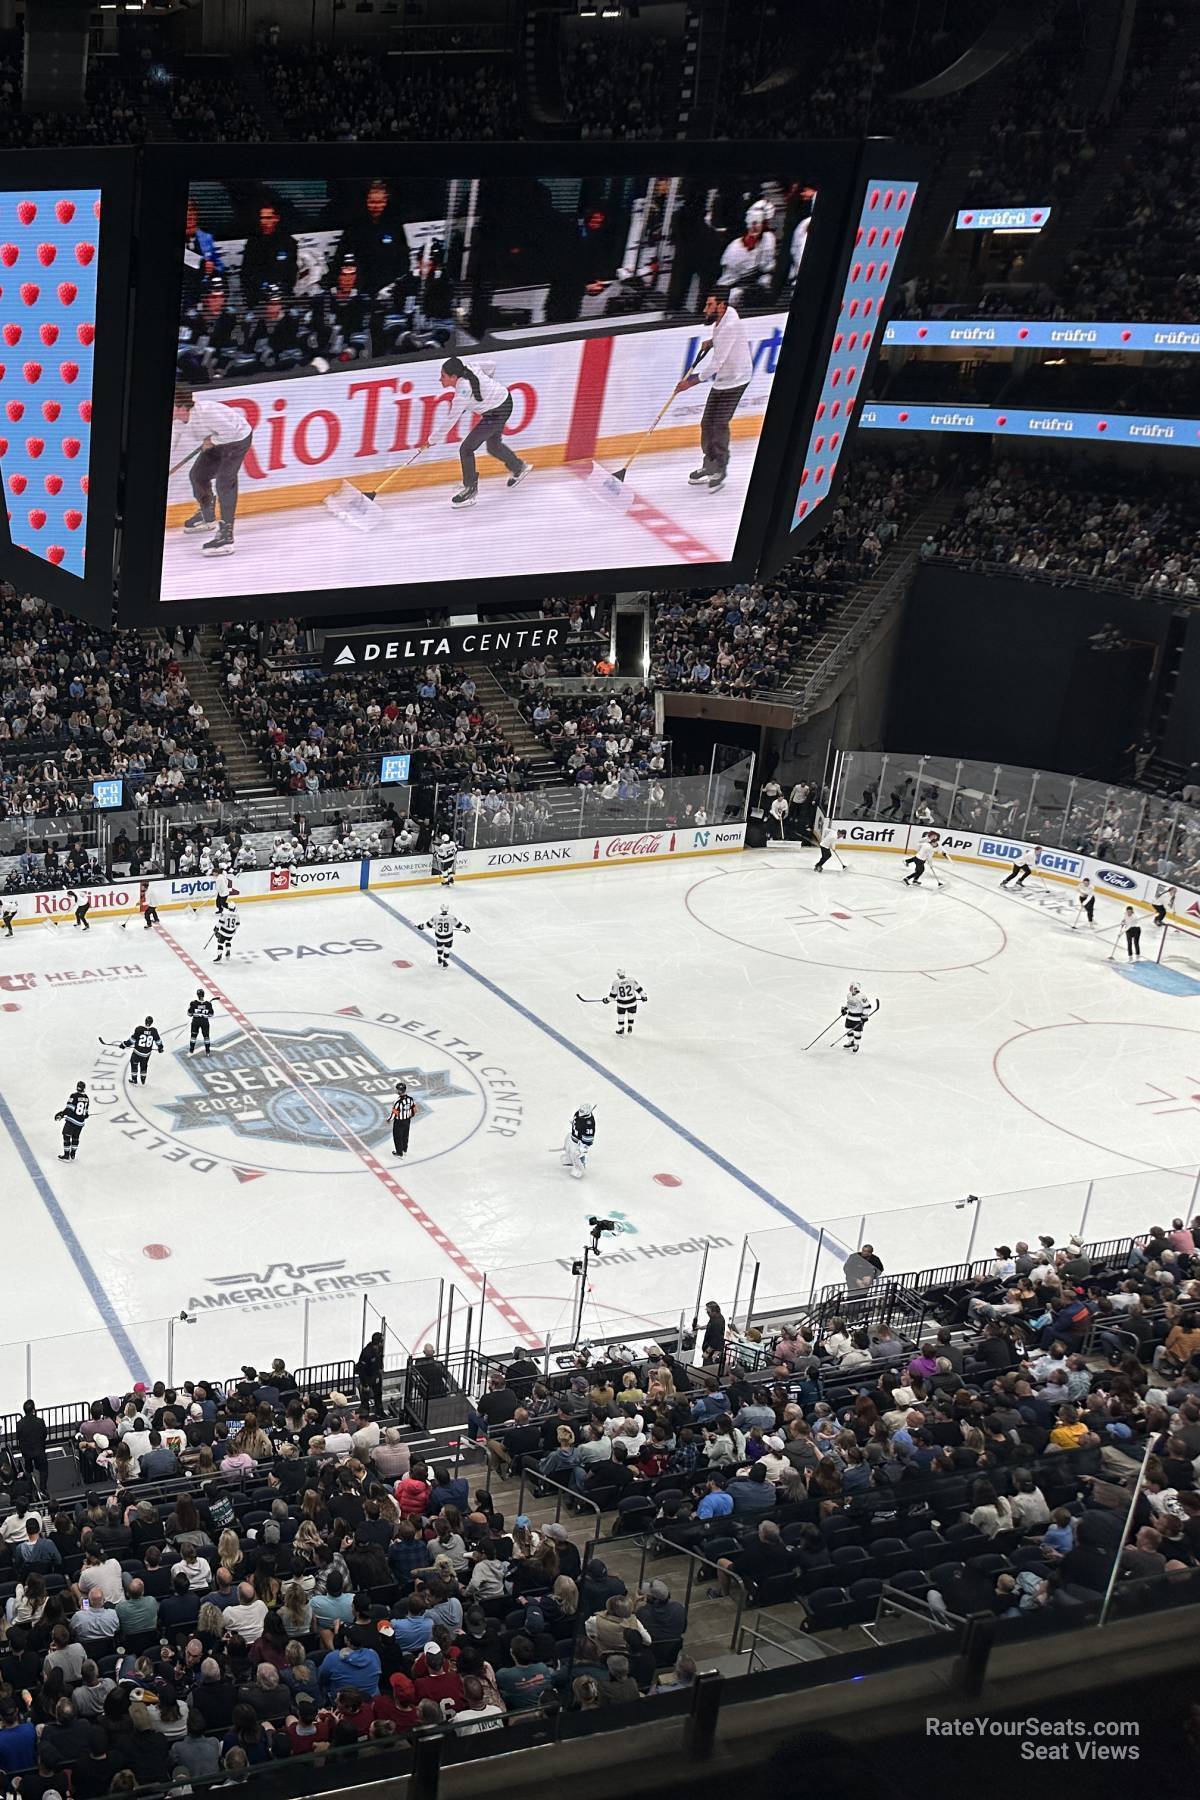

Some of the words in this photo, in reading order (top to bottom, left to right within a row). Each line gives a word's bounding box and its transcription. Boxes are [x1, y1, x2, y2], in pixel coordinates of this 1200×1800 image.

[950, 327, 996, 340] trüfrü
[1051, 328, 1097, 342] trüfrü
[1154, 331, 1200, 345] trüfrü
[930, 413, 974, 426] trüfrü
[1028, 418, 1073, 431] trüfrü
[1129, 423, 1174, 438] trüfrü
[364, 637, 451, 661] DELTA
[462, 628, 559, 653] CENTER
[715, 831, 742, 843] Nomi
[850, 826, 895, 843] Garff
[488, 850, 530, 866] ZIONS
[534, 848, 571, 861] BANK
[982, 842, 1022, 859] BUD
[1035, 854, 1080, 873] IGHT
[296, 871, 340, 883] TOYOTA
[1103, 871, 1130, 888] Ford
[437, 922, 449, 933] 39
[262, 938, 383, 962] PACS
[44, 964, 143, 982] HEALTH
[203, 1054, 382, 1094] SEASON
[376, 1012, 484, 1062] DELTA
[481, 1066, 523, 1138] CENTER
[194, 1093, 259, 1113] 2024
[109, 1112, 219, 1173] DELTA
[637, 1233, 734, 1259] Health
[188, 1282, 313, 1311] AMERICA
[314, 1269, 393, 1292] FIRST
[241, 1300, 299, 1313] CREDIT
[309, 1291, 357, 1304] UNION
